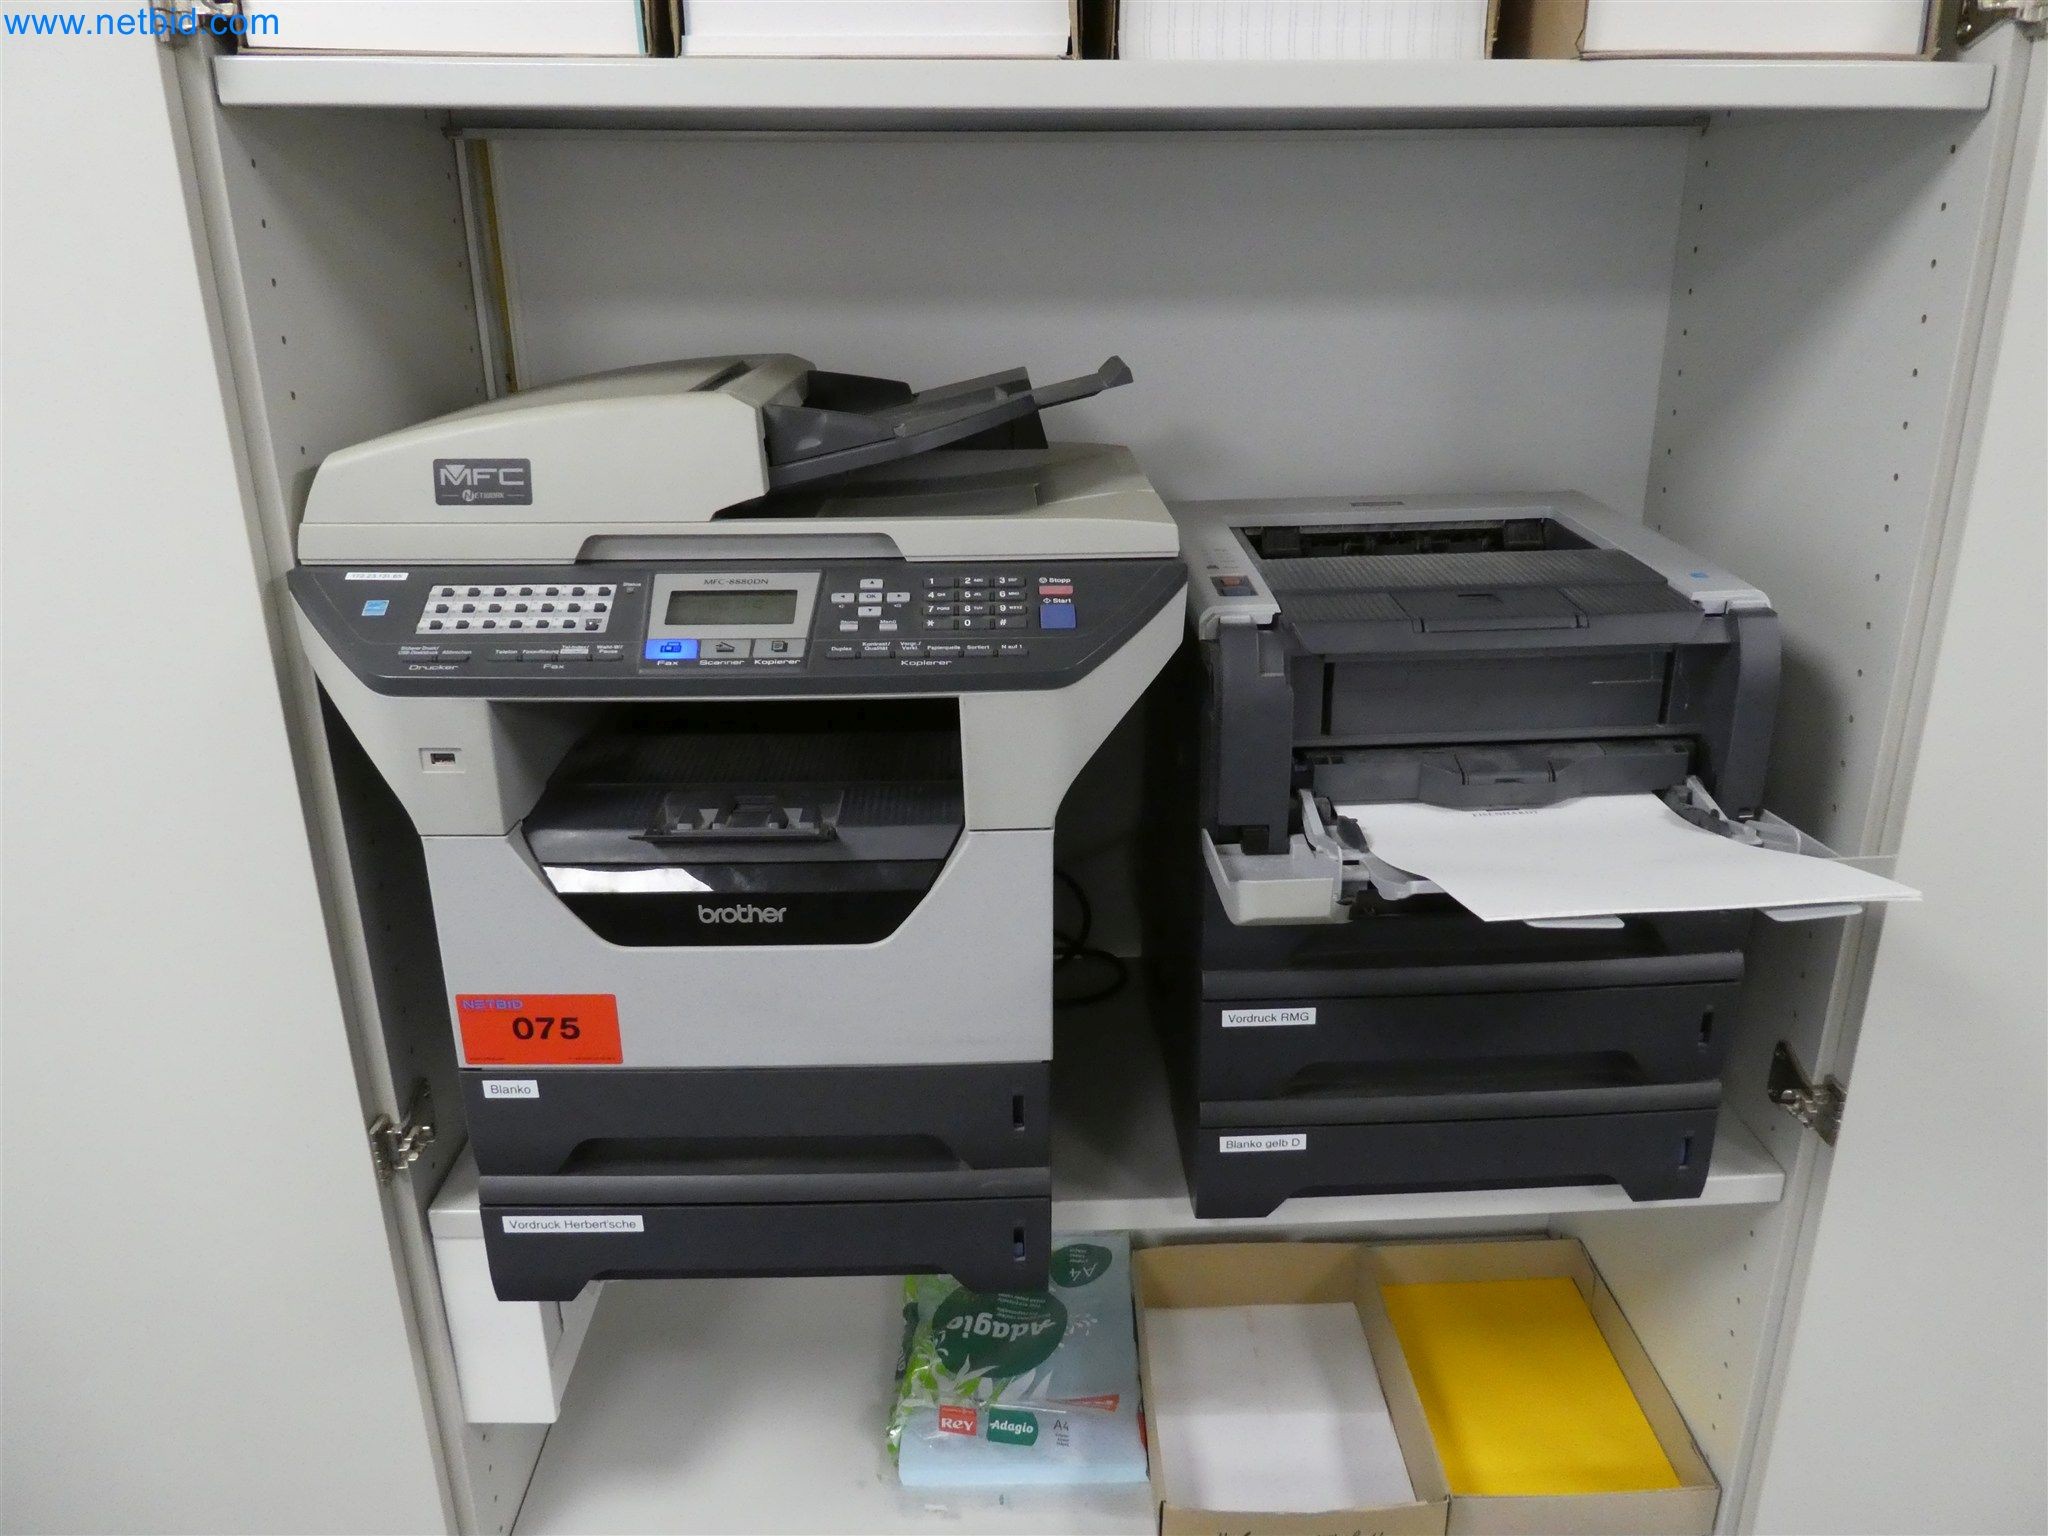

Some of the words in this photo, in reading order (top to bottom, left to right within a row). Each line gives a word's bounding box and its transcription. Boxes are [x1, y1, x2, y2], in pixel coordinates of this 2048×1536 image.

[440, 464, 525, 485] MFC
[928, 591, 934, 599] 4
[964, 590, 971, 598] 5
[999, 590, 1006, 598] 6
[698, 904, 787, 924] brother
[463, 1000, 523, 1010] NETBID
[1228, 1012, 1277, 1024] Vordruck
[1281, 1011, 1309, 1022] RMG
[512, 1016, 580, 1041] 075
[490, 1084, 531, 1095] Blanko
[1226, 1139, 1263, 1149] Blanko
[1265, 1138, 1289, 1149] gelb
[1291, 1138, 1300, 1147] D
[510, 1220, 560, 1230] Vordruck
[1069, 1262, 1099, 1282] A4
[946, 1311, 1056, 1342] Adagio
[989, 1420, 1034, 1435] Adagio
[1053, 1419, 1069, 1431] A4
